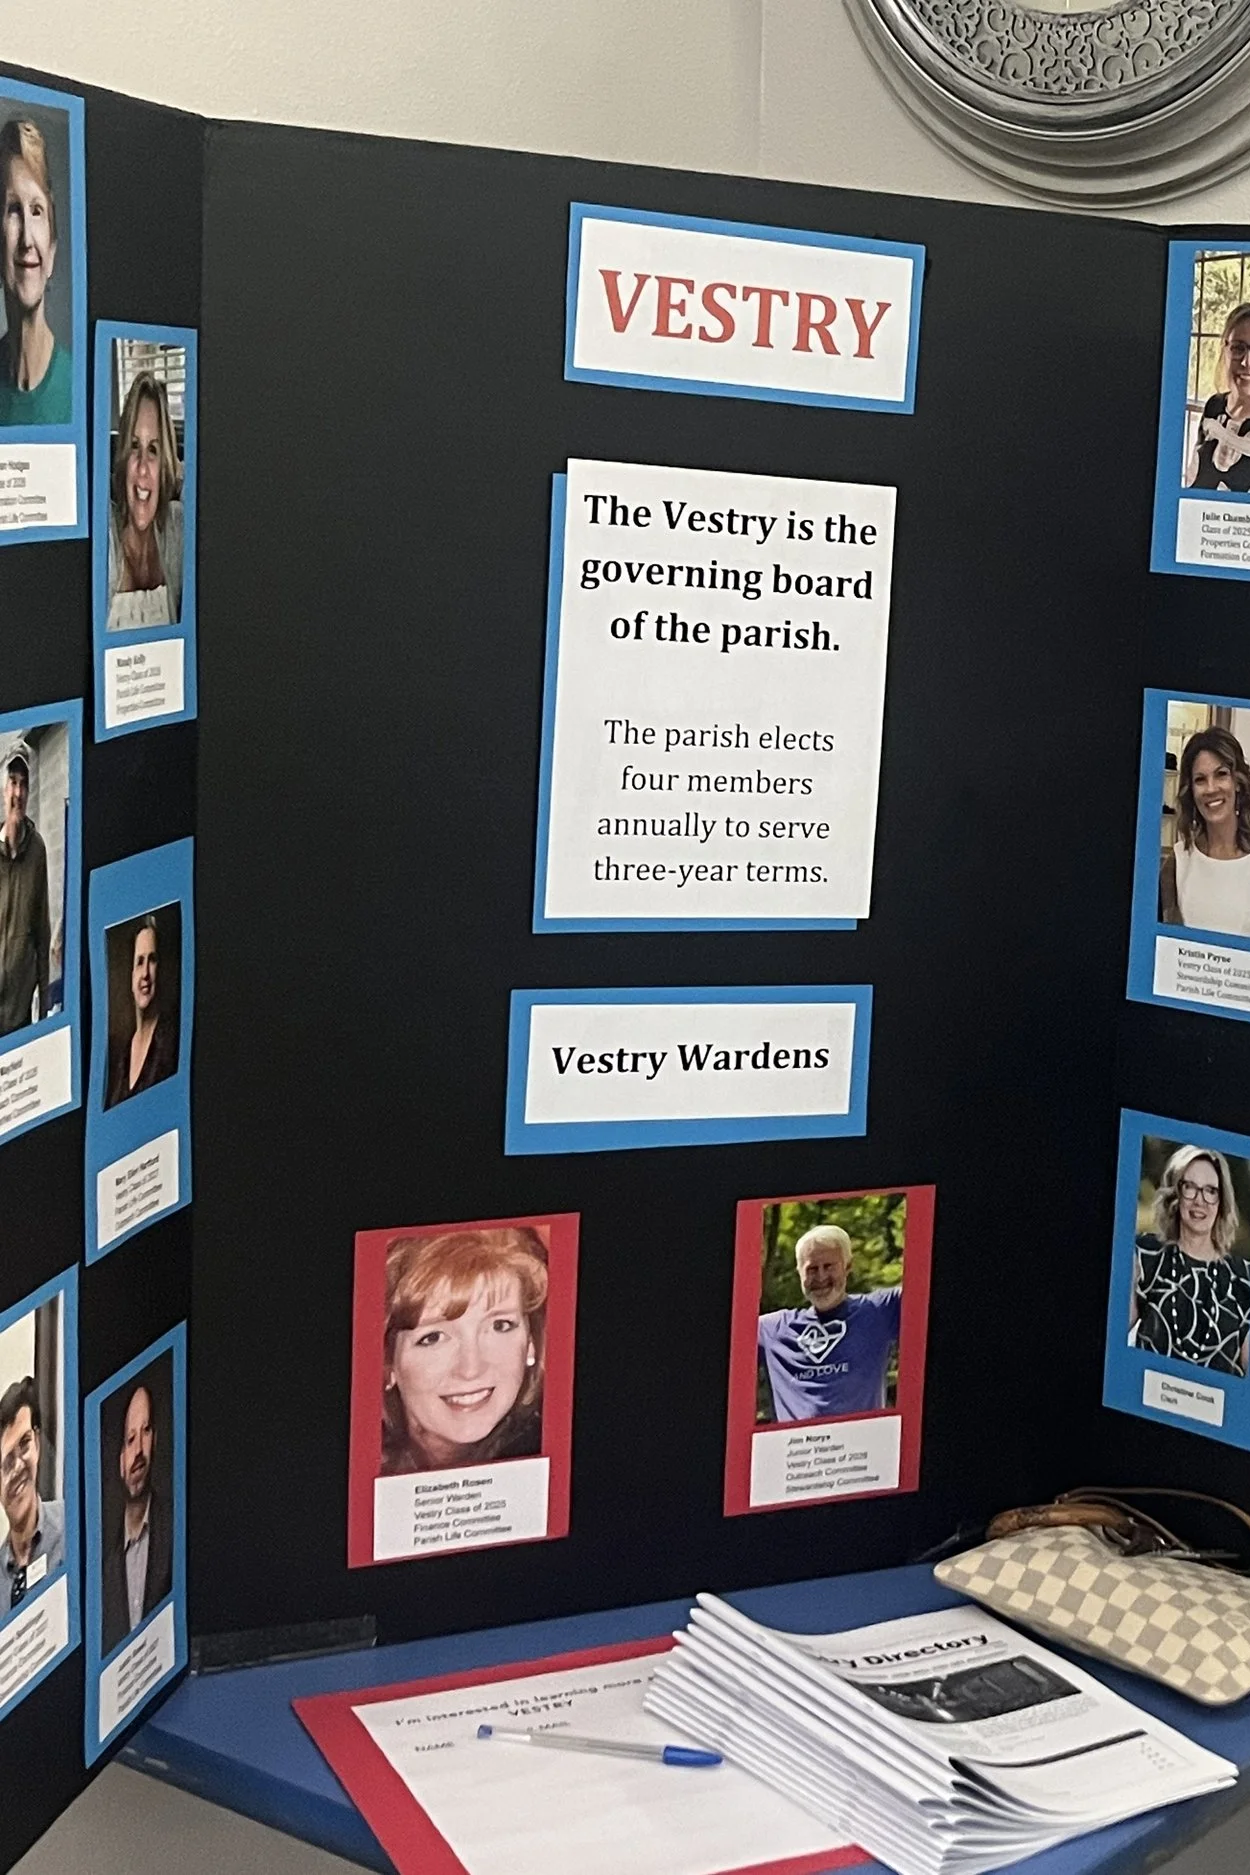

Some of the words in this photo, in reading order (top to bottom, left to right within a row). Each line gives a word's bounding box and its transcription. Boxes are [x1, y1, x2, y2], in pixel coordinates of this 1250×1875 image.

[598, 269, 892, 359] VESTRY
[584, 494, 651, 527] The
[663, 501, 778, 545] Vestry
[786, 511, 814, 541] is
[825, 514, 877, 545] the
[1202, 512, 1220, 522] Julie
[1202, 524, 1221, 534] Class
[1223, 526, 1231, 534] of
[580, 558, 763, 600] governing
[773, 564, 873, 600] board
[610, 611, 649, 640] of
[655, 612, 711, 643] the
[720, 620, 840, 653] parish.
[604, 720, 656, 744] The
[665, 724, 750, 752] parish
[759, 725, 835, 752] elects
[621, 766, 679, 791] four
[687, 770, 813, 794] members
[597, 812, 716, 843] annually
[725, 817, 750, 838] to
[758, 819, 830, 839] serve
[594, 857, 738, 888] three-year
[746, 861, 828, 883] terms.
[1207, 952, 1231, 963] Payne
[552, 1047, 667, 1080] Vestry
[677, 1042, 830, 1072] Wardens
[415, 1482, 459, 1494] Elizabeth
[447, 1492, 481, 1502] Warden
[414, 1510, 442, 1519] Vestry
[445, 1507, 470, 1515] Class
[473, 1503, 482, 1512] of
[414, 1522, 450, 1532] Finance
[452, 1515, 501, 1527] Committee
[414, 1535, 442, 1545] Parish
[464, 1526, 512, 1537] Committee
[863, 1634, 988, 1665] Directory
